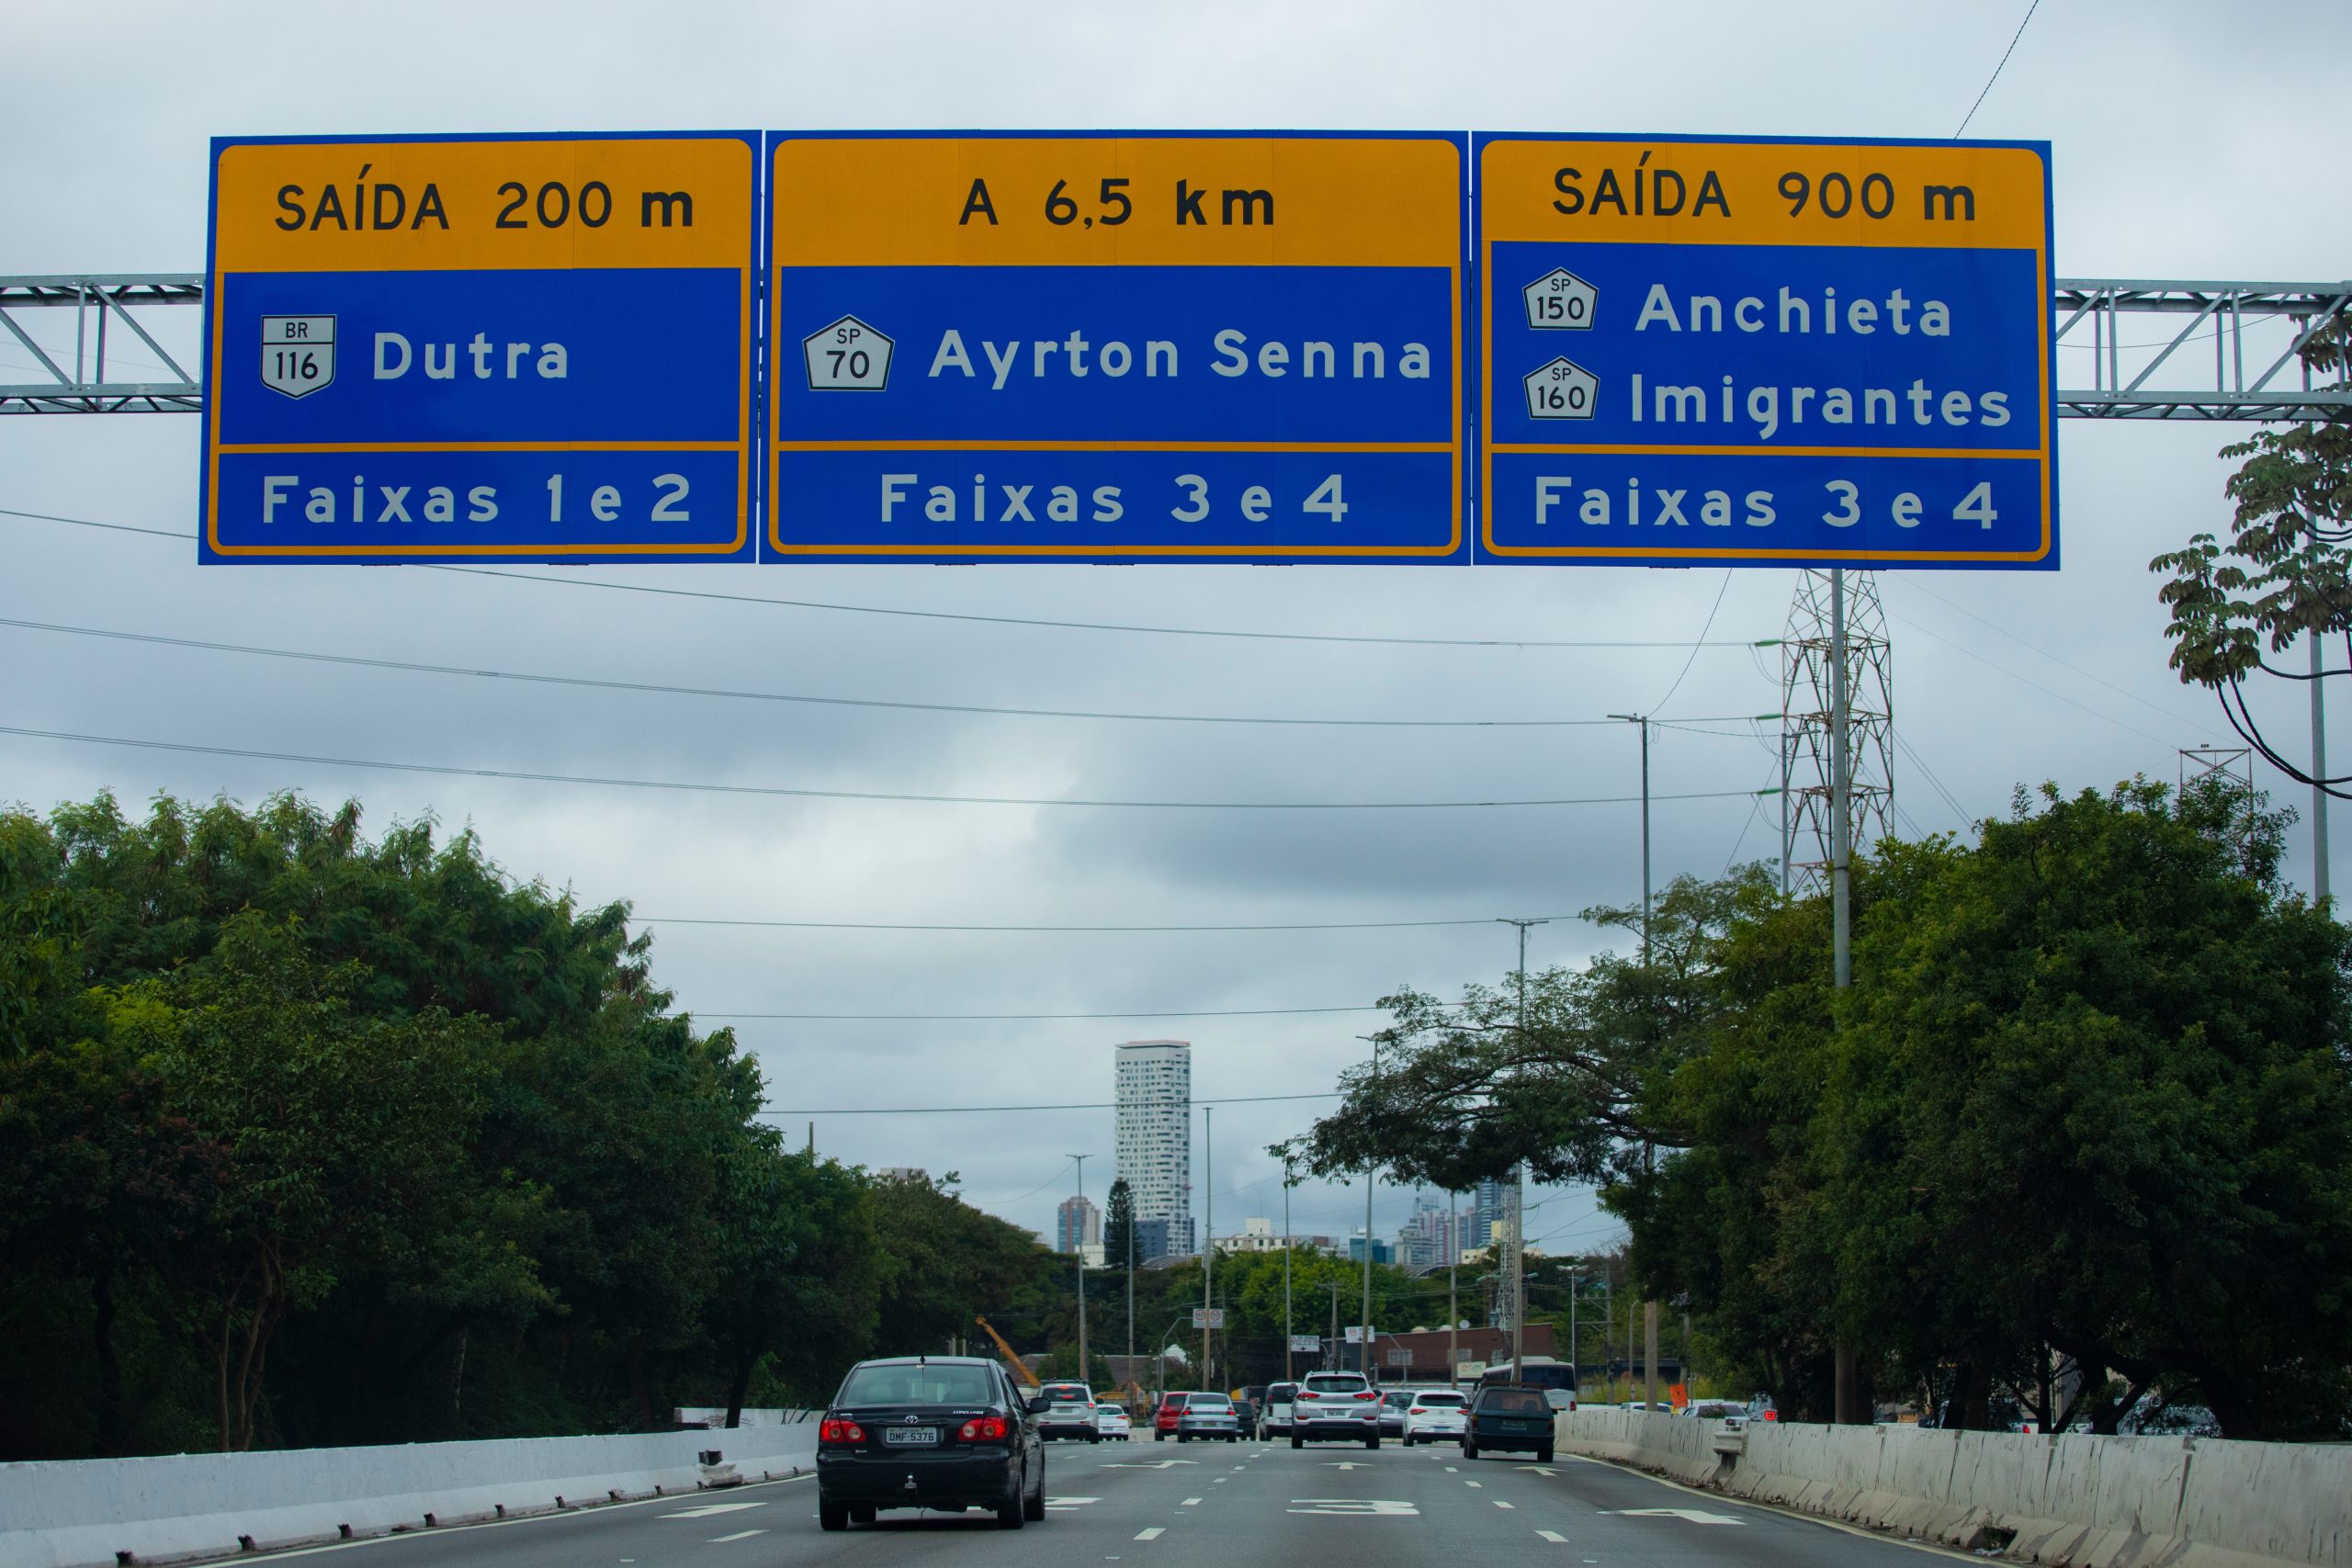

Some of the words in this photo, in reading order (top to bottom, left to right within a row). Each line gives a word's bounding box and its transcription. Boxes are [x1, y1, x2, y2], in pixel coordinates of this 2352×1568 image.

[275, 164, 450, 231] SAÍDA
[495, 180, 613, 229] 200
[640, 191, 693, 228] m
[958, 178, 999, 226] A
[1045, 178, 1132, 230] 6,5
[1176, 178, 1274, 226] km
[1553, 150, 1732, 218] SAÍDA
[1778, 171, 1894, 220] 900
[1923, 185, 1975, 221] m
[1537, 296, 1585, 321] 150
[1551, 277, 1571, 292] SP
[285, 321, 309, 339] BR
[1634, 284, 1951, 337] Anchieta
[373, 332, 568, 380] Dutra
[836, 328, 861, 344] SP
[928, 329, 1178, 390] Ayrton
[1210, 329, 1430, 378] Senna
[276, 351, 319, 380] 116
[826, 350, 870, 379] 70
[1552, 367, 1572, 381] SP
[1538, 385, 1586, 410] 160
[1632, 373, 2011, 440] Imigrantes
[263, 475, 499, 524] Faixas
[547, 474, 562, 522] 1
[590, 485, 622, 522] e
[650, 473, 690, 522] 2
[881, 473, 1124, 523] Faixas
[1170, 473, 1210, 523] 3
[1240, 485, 1272, 523] e
[1302, 474, 1349, 523] 4
[1535, 476, 1777, 527] Faixas
[1822, 479, 1860, 527] 3
[1891, 491, 1923, 528] e
[1952, 481, 1998, 530] 4
